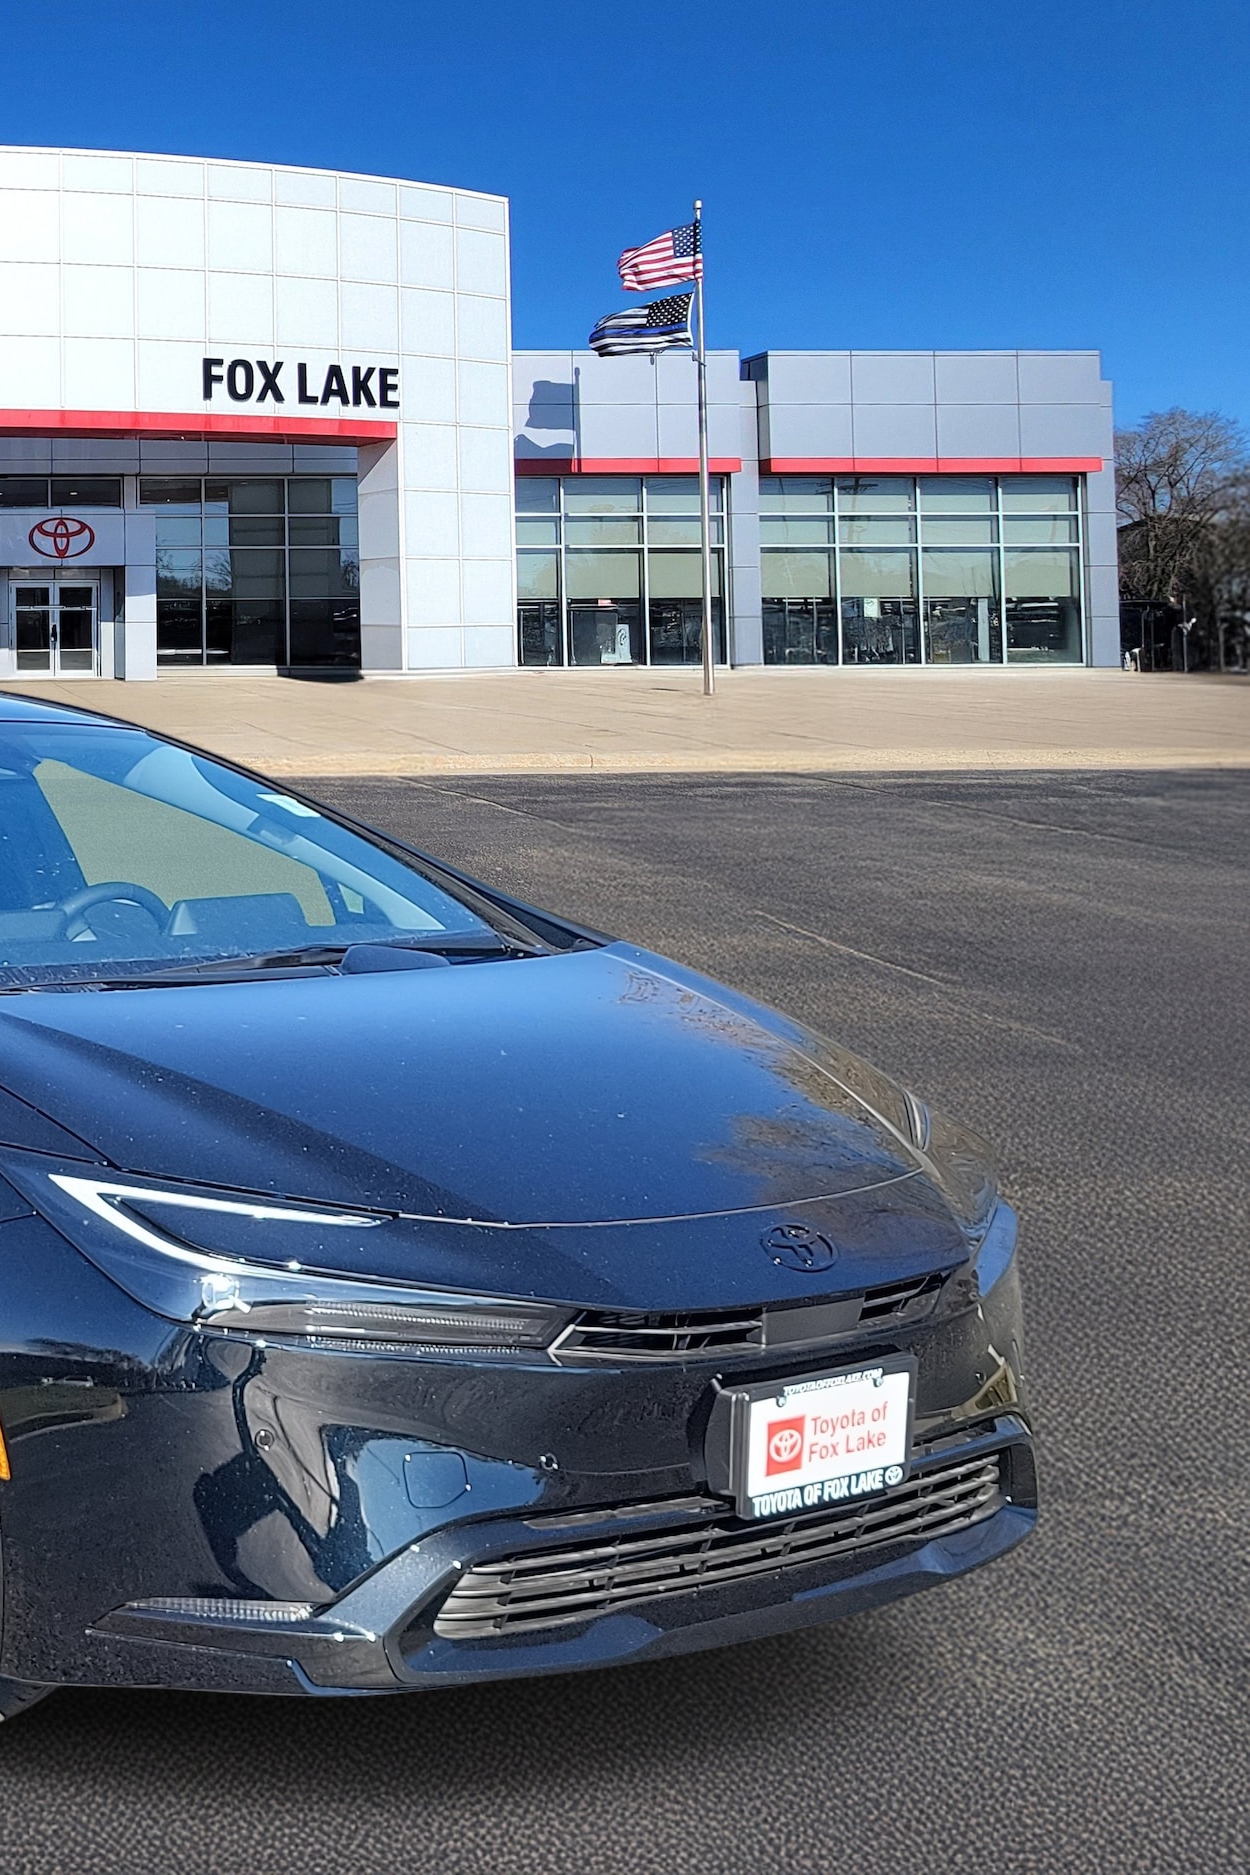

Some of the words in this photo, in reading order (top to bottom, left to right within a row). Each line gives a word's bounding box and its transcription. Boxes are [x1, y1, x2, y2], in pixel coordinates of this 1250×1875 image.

[203, 358, 285, 403] FOX
[297, 363, 400, 407] LAKE
[811, 1408, 866, 1437] Toyota
[871, 1401, 888, 1422] of
[808, 1442, 839, 1462] Fox
[846, 1430, 886, 1453] Lake
[752, 1488, 803, 1517] TOYOTA
[804, 1483, 822, 1506] OF
[823, 1476, 850, 1501] FOX
[851, 1469, 884, 1495] LAKE
